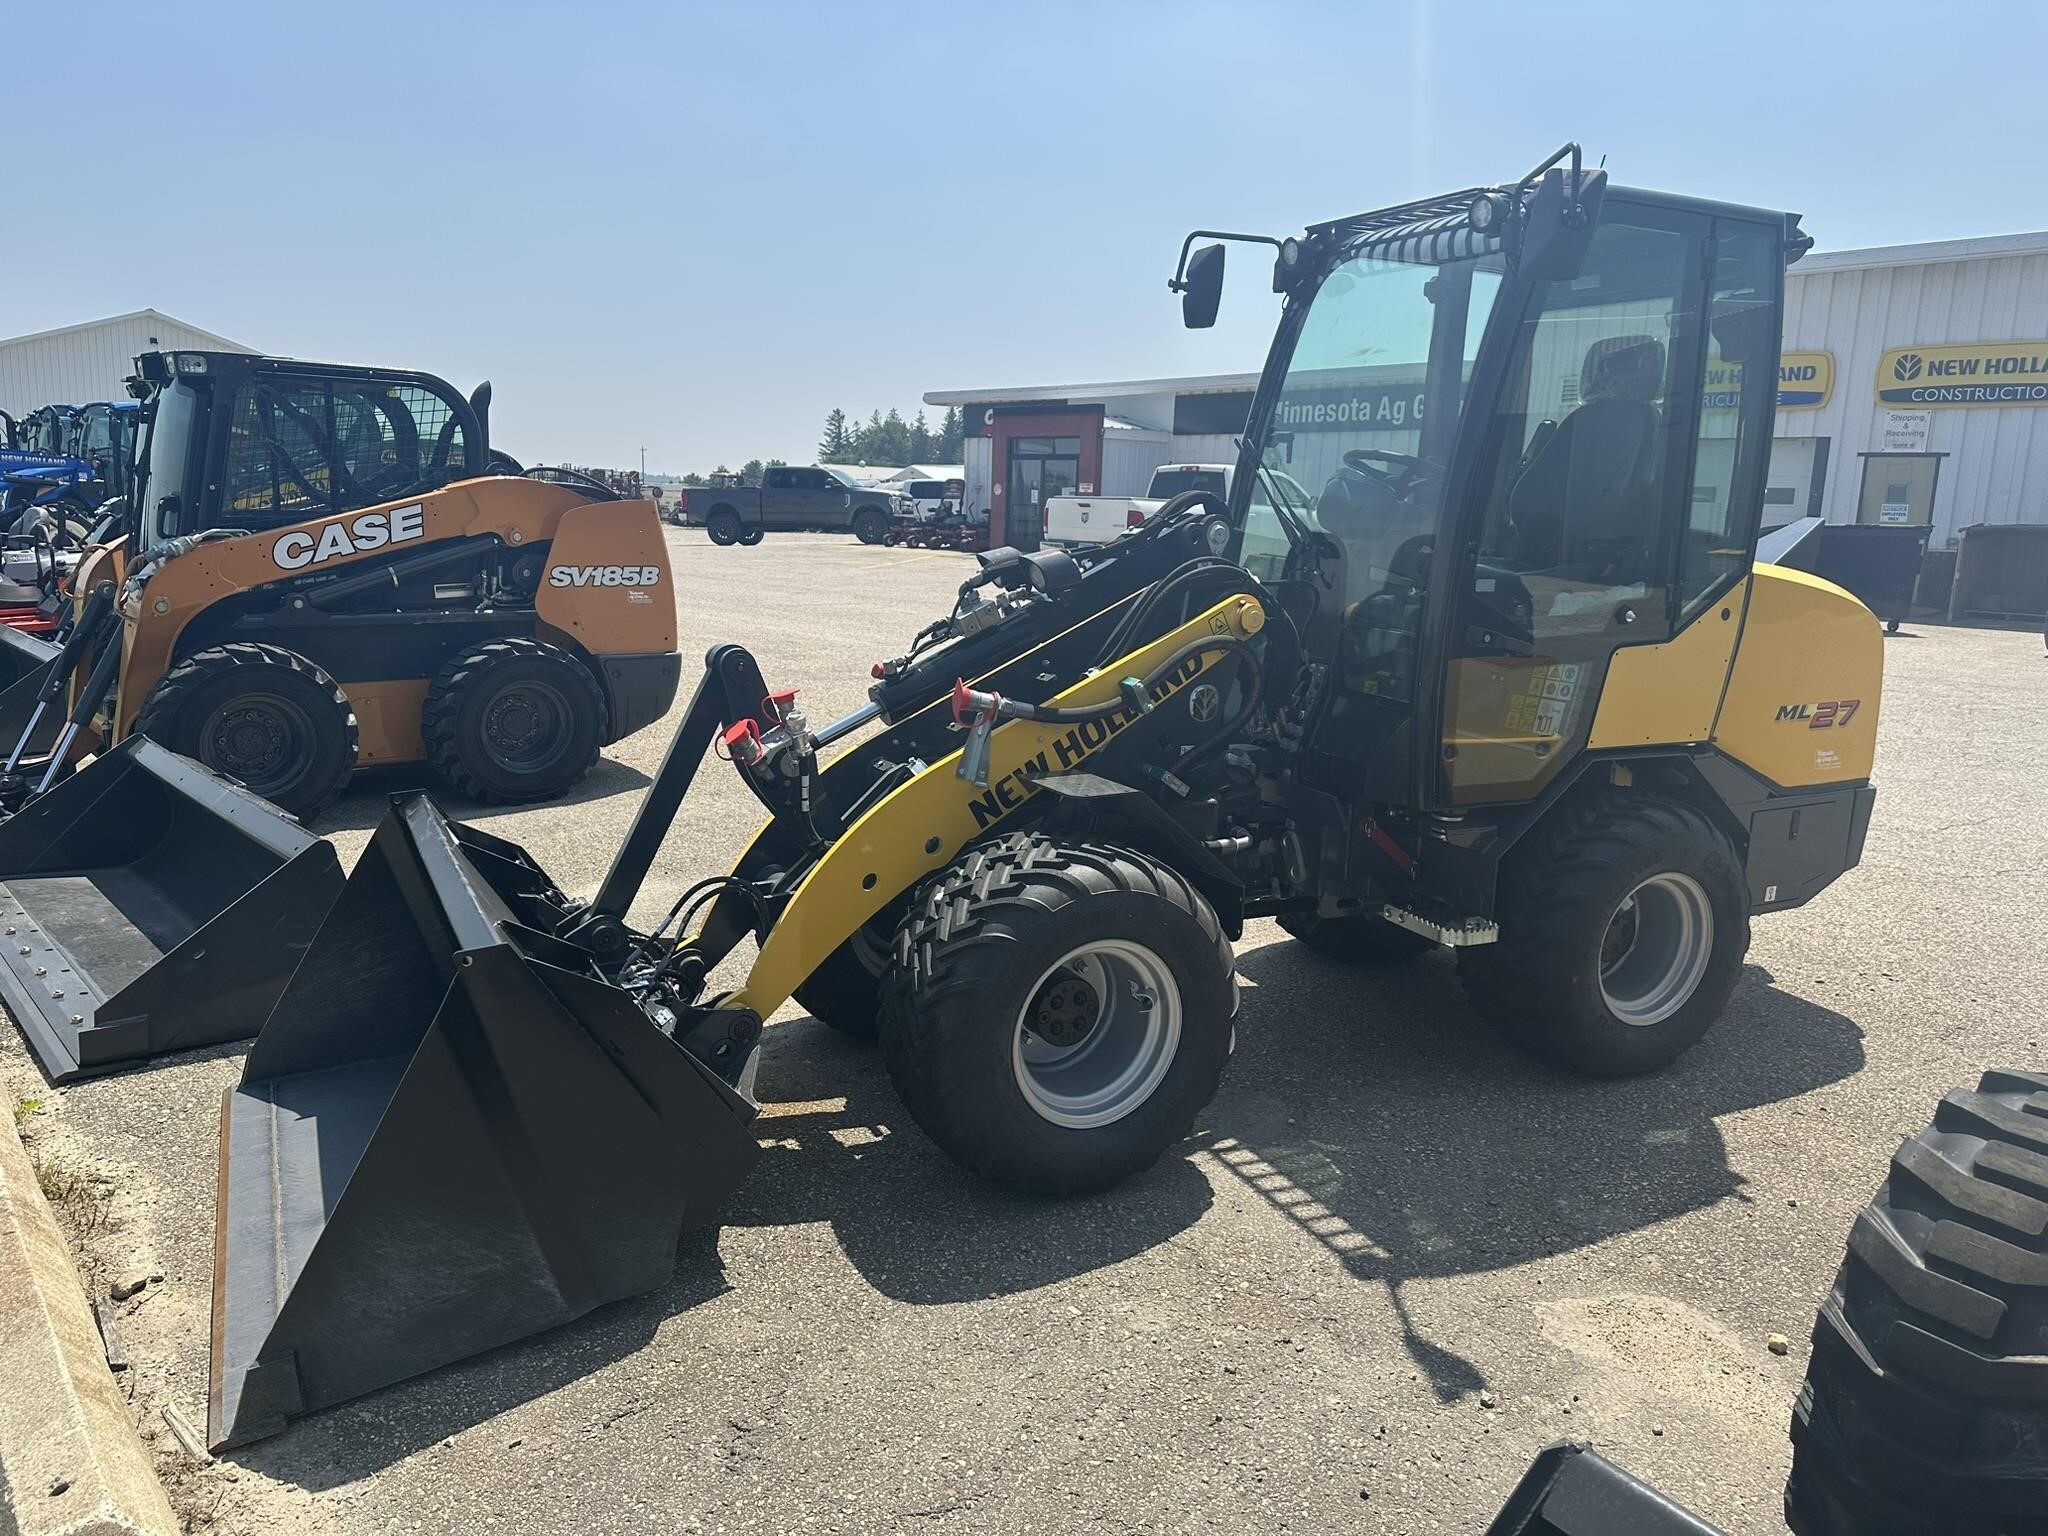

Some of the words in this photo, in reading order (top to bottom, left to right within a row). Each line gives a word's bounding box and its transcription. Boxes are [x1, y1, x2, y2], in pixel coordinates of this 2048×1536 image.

[1927, 358, 1981, 377] NEW
[1984, 356, 2048, 375] HOLL
[1911, 385, 2047, 401] CONSTRUCTIO
[1376, 396, 1406, 425] Ag
[1890, 414, 1926, 422] Shipping
[0, 454, 23, 463] NEW
[25, 456, 67, 466] HOLLAND
[272, 502, 425, 571] CASE
[549, 565, 661, 588] SV185B
[1775, 700, 1861, 729] ML27
[968, 751, 1051, 829] NEW
